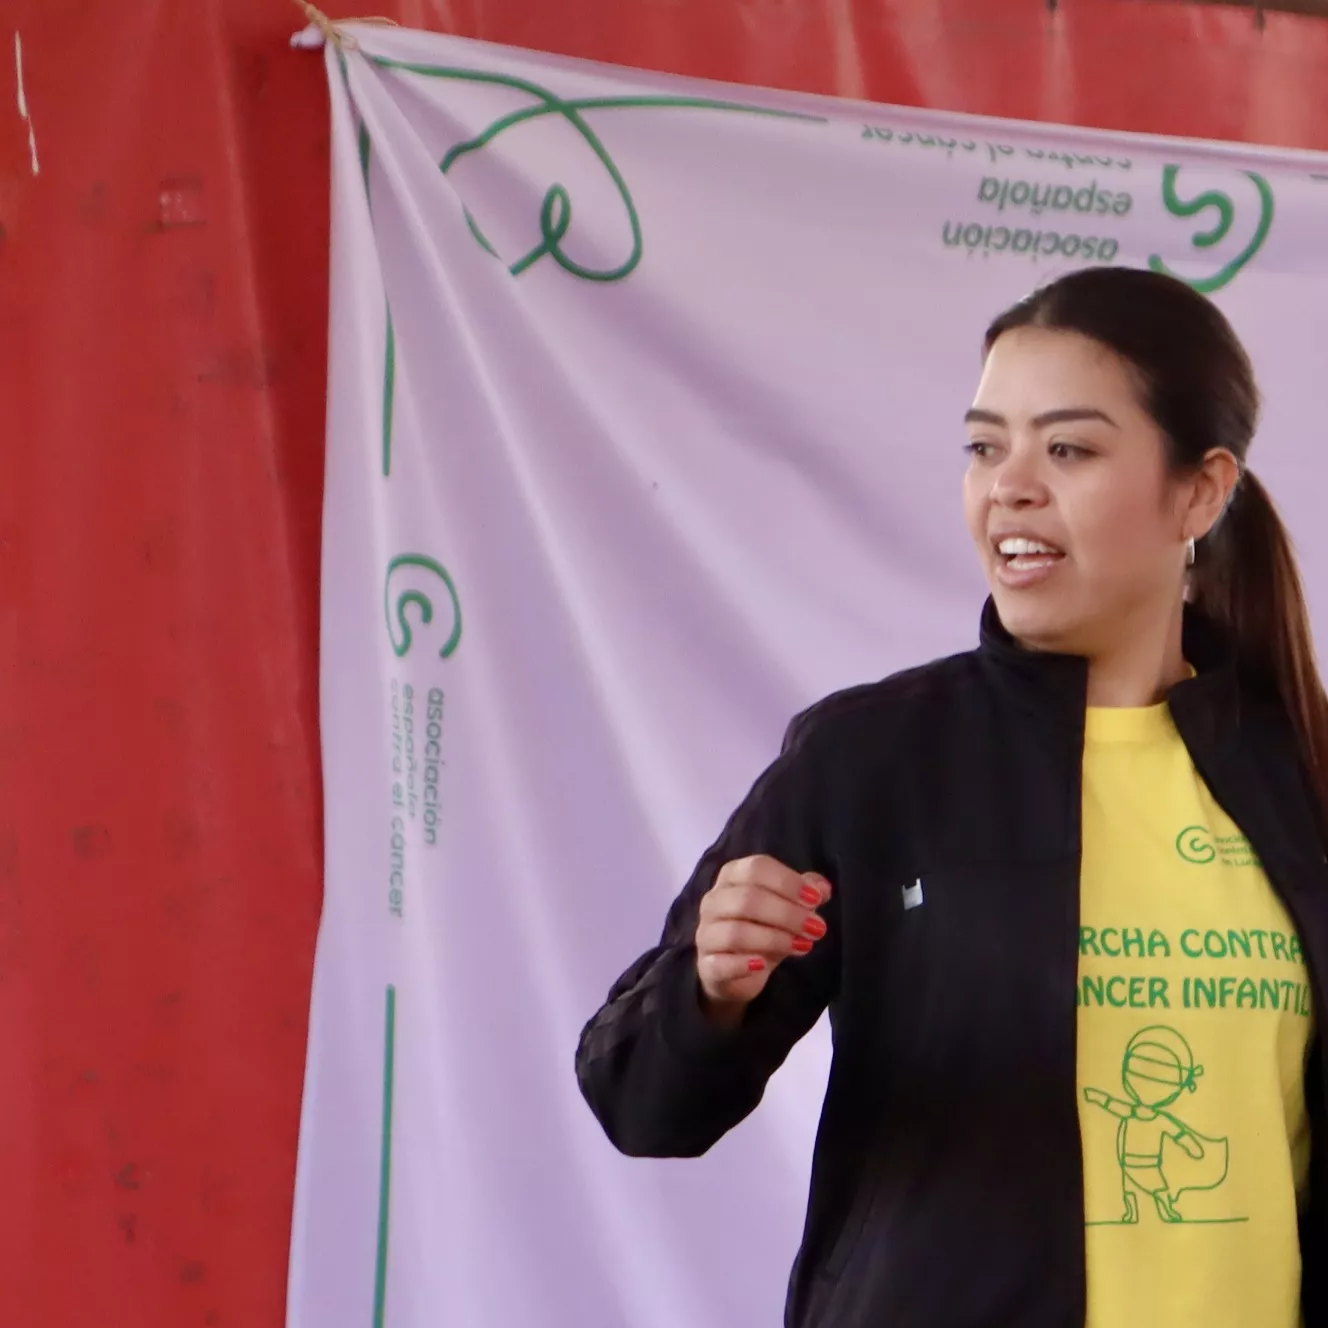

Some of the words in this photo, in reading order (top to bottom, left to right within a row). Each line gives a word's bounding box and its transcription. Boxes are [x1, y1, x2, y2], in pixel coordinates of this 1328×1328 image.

[978, 175, 1132, 216] española
[1079, 926, 1170, 958] RCHA
[1077, 976, 1169, 1008] NCER
[1182, 977, 1312, 1016] INFANTIL
